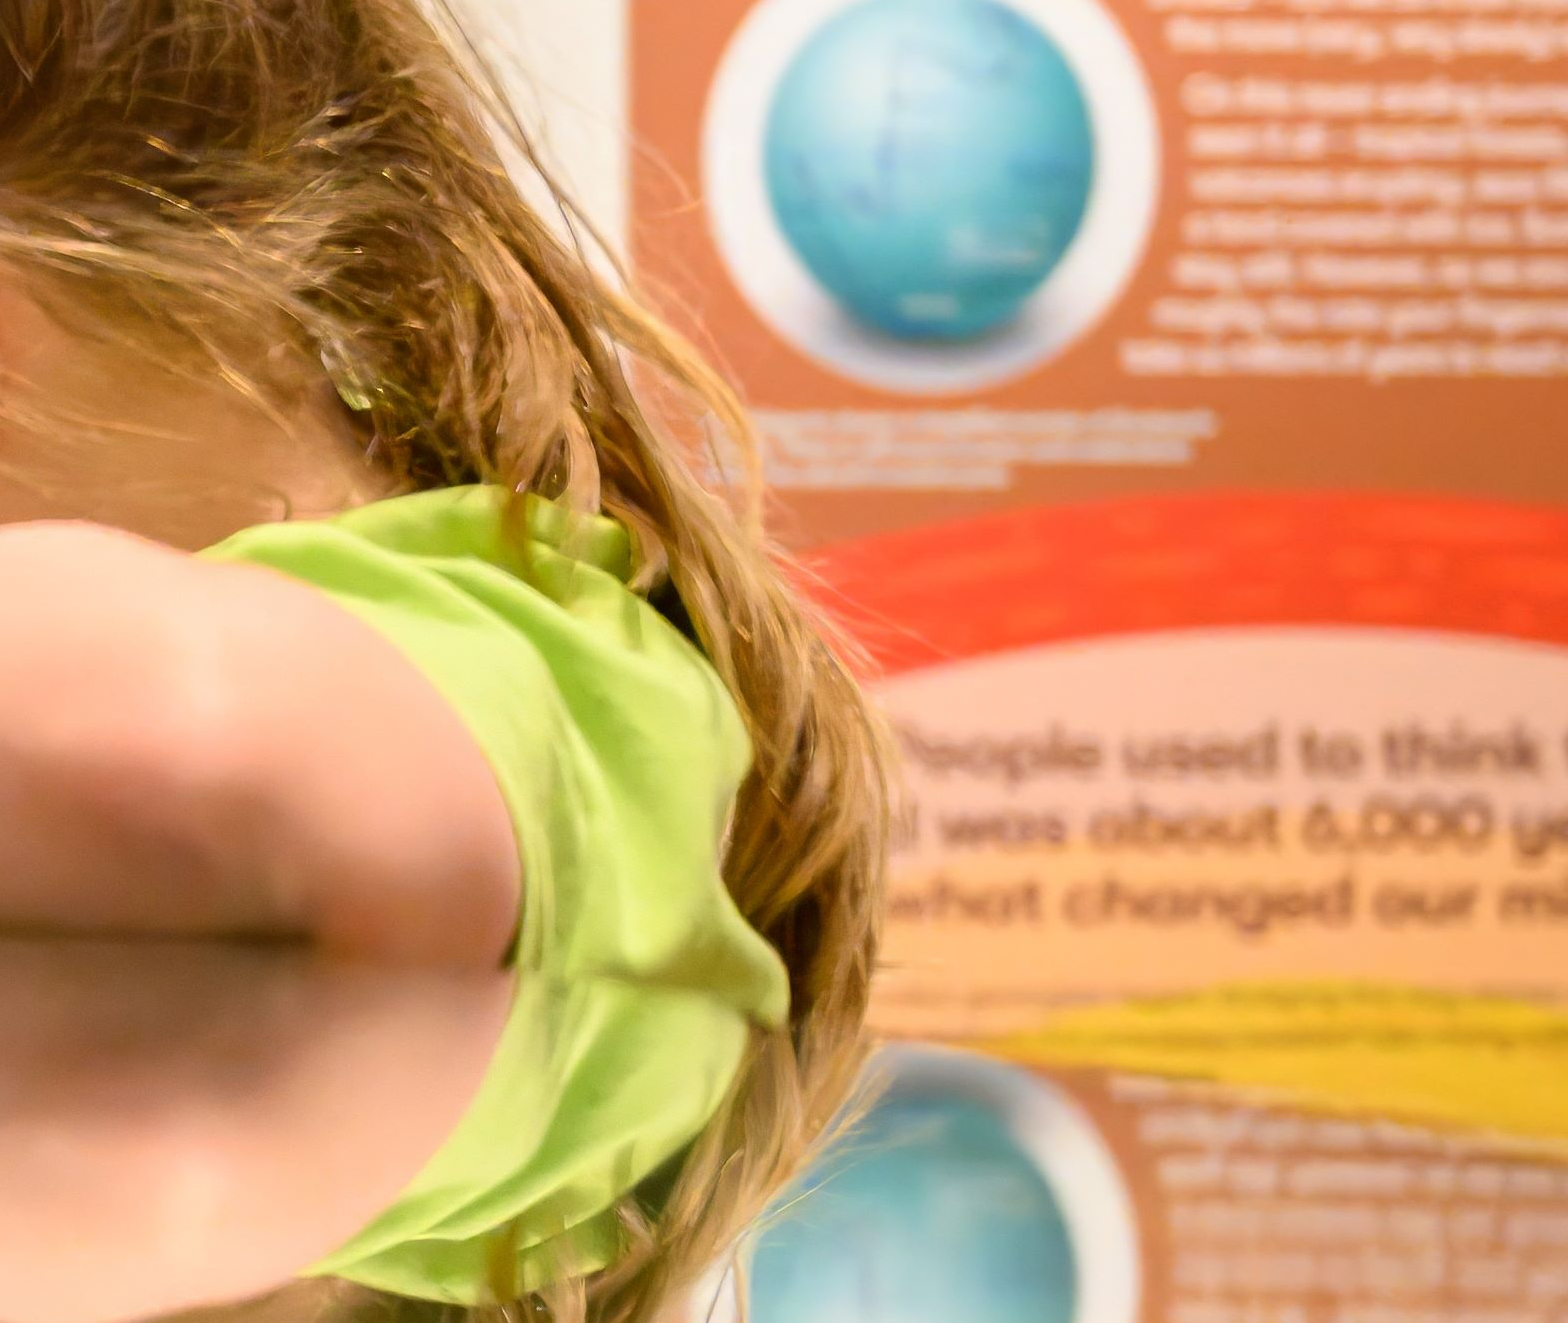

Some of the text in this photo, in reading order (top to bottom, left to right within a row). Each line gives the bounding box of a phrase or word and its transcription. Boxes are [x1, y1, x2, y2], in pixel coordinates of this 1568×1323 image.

[1119, 719, 1279, 779] used
[1297, 721, 1361, 778] to
[1381, 717, 1545, 779] think
